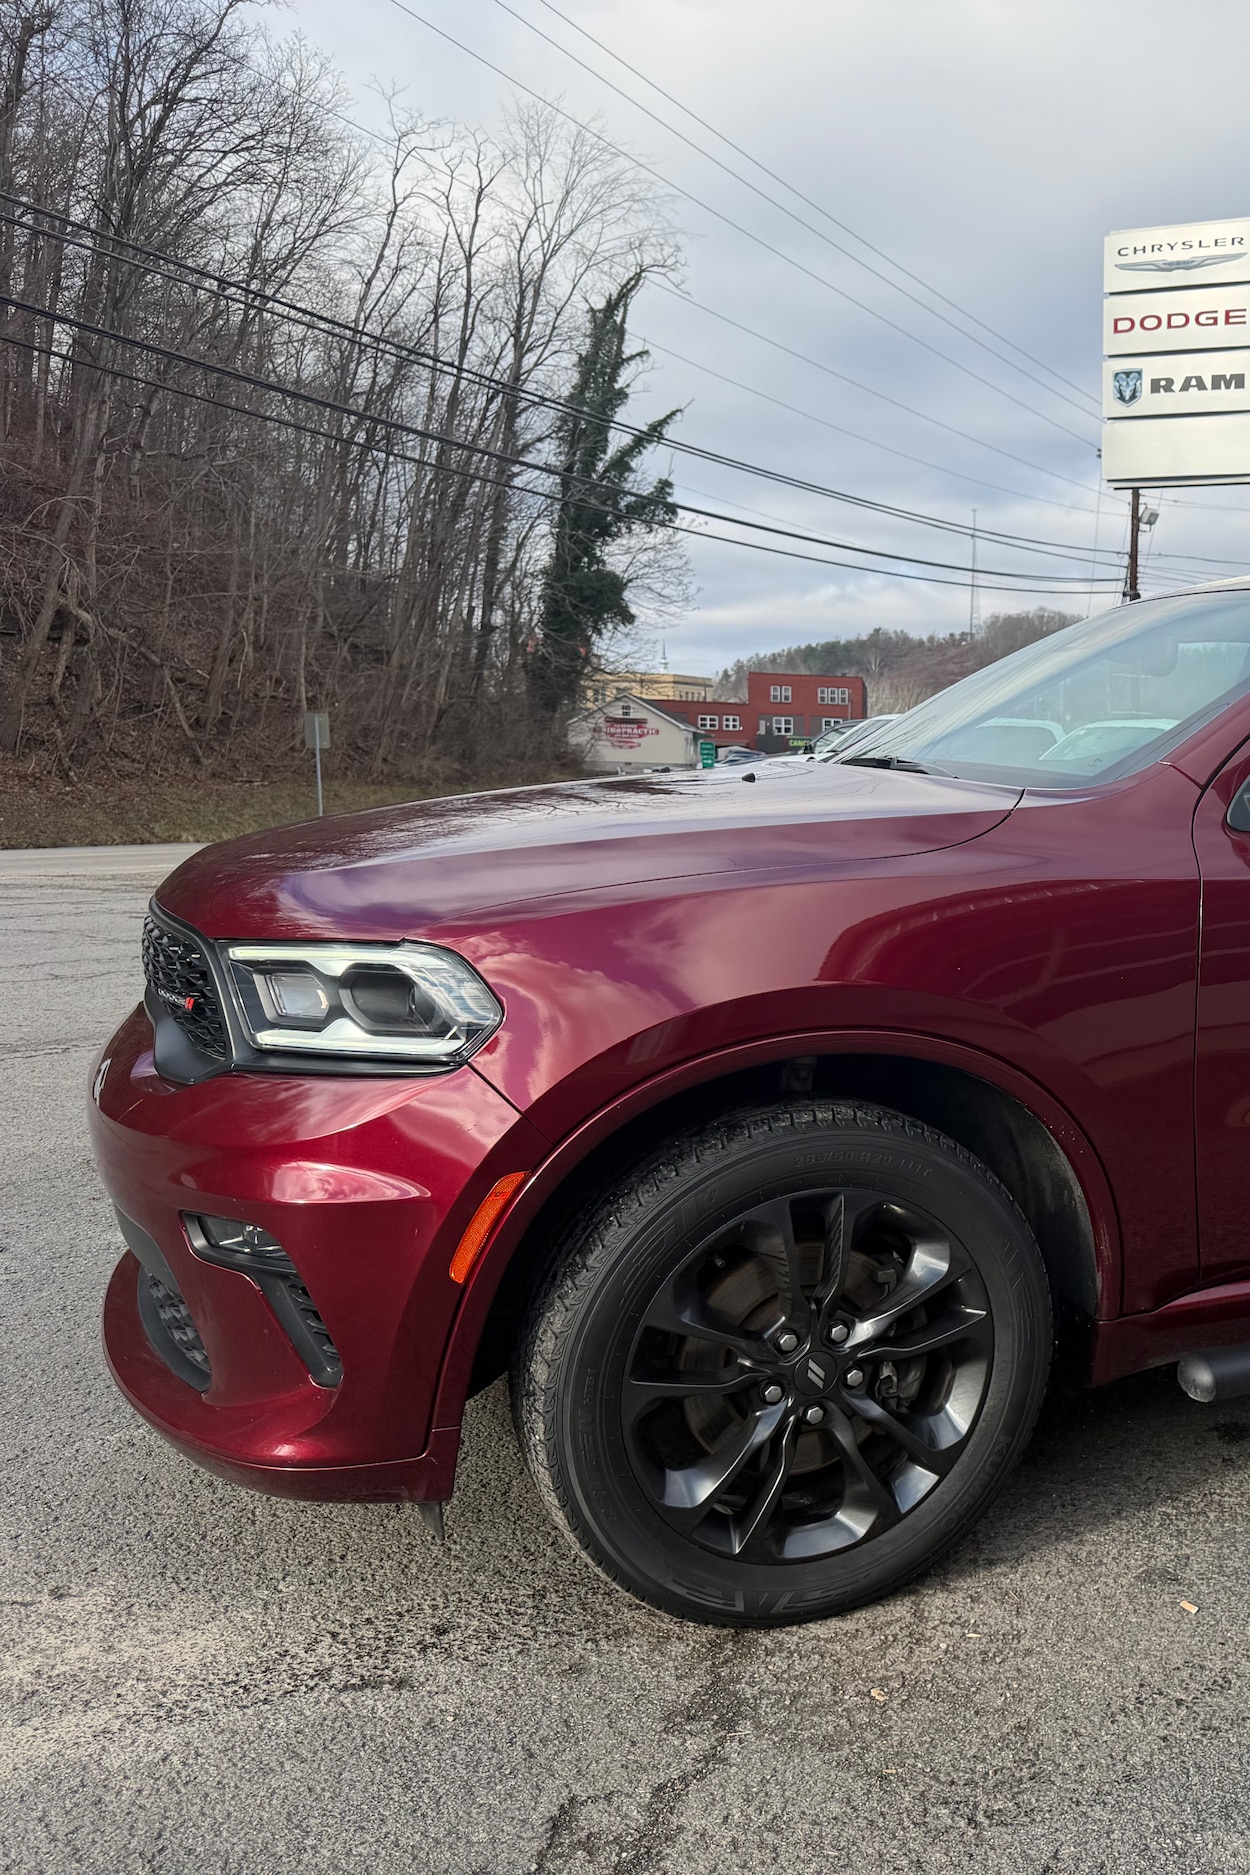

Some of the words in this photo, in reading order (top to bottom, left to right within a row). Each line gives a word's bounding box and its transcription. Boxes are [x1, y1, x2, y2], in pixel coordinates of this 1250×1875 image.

[1117, 237, 1245, 256] CHRYSLER
[1113, 308, 1247, 334] DODGE
[1150, 373, 1245, 394] RAM
[793, 1150, 855, 1168] 265/50
[859, 1151, 894, 1165] R20
